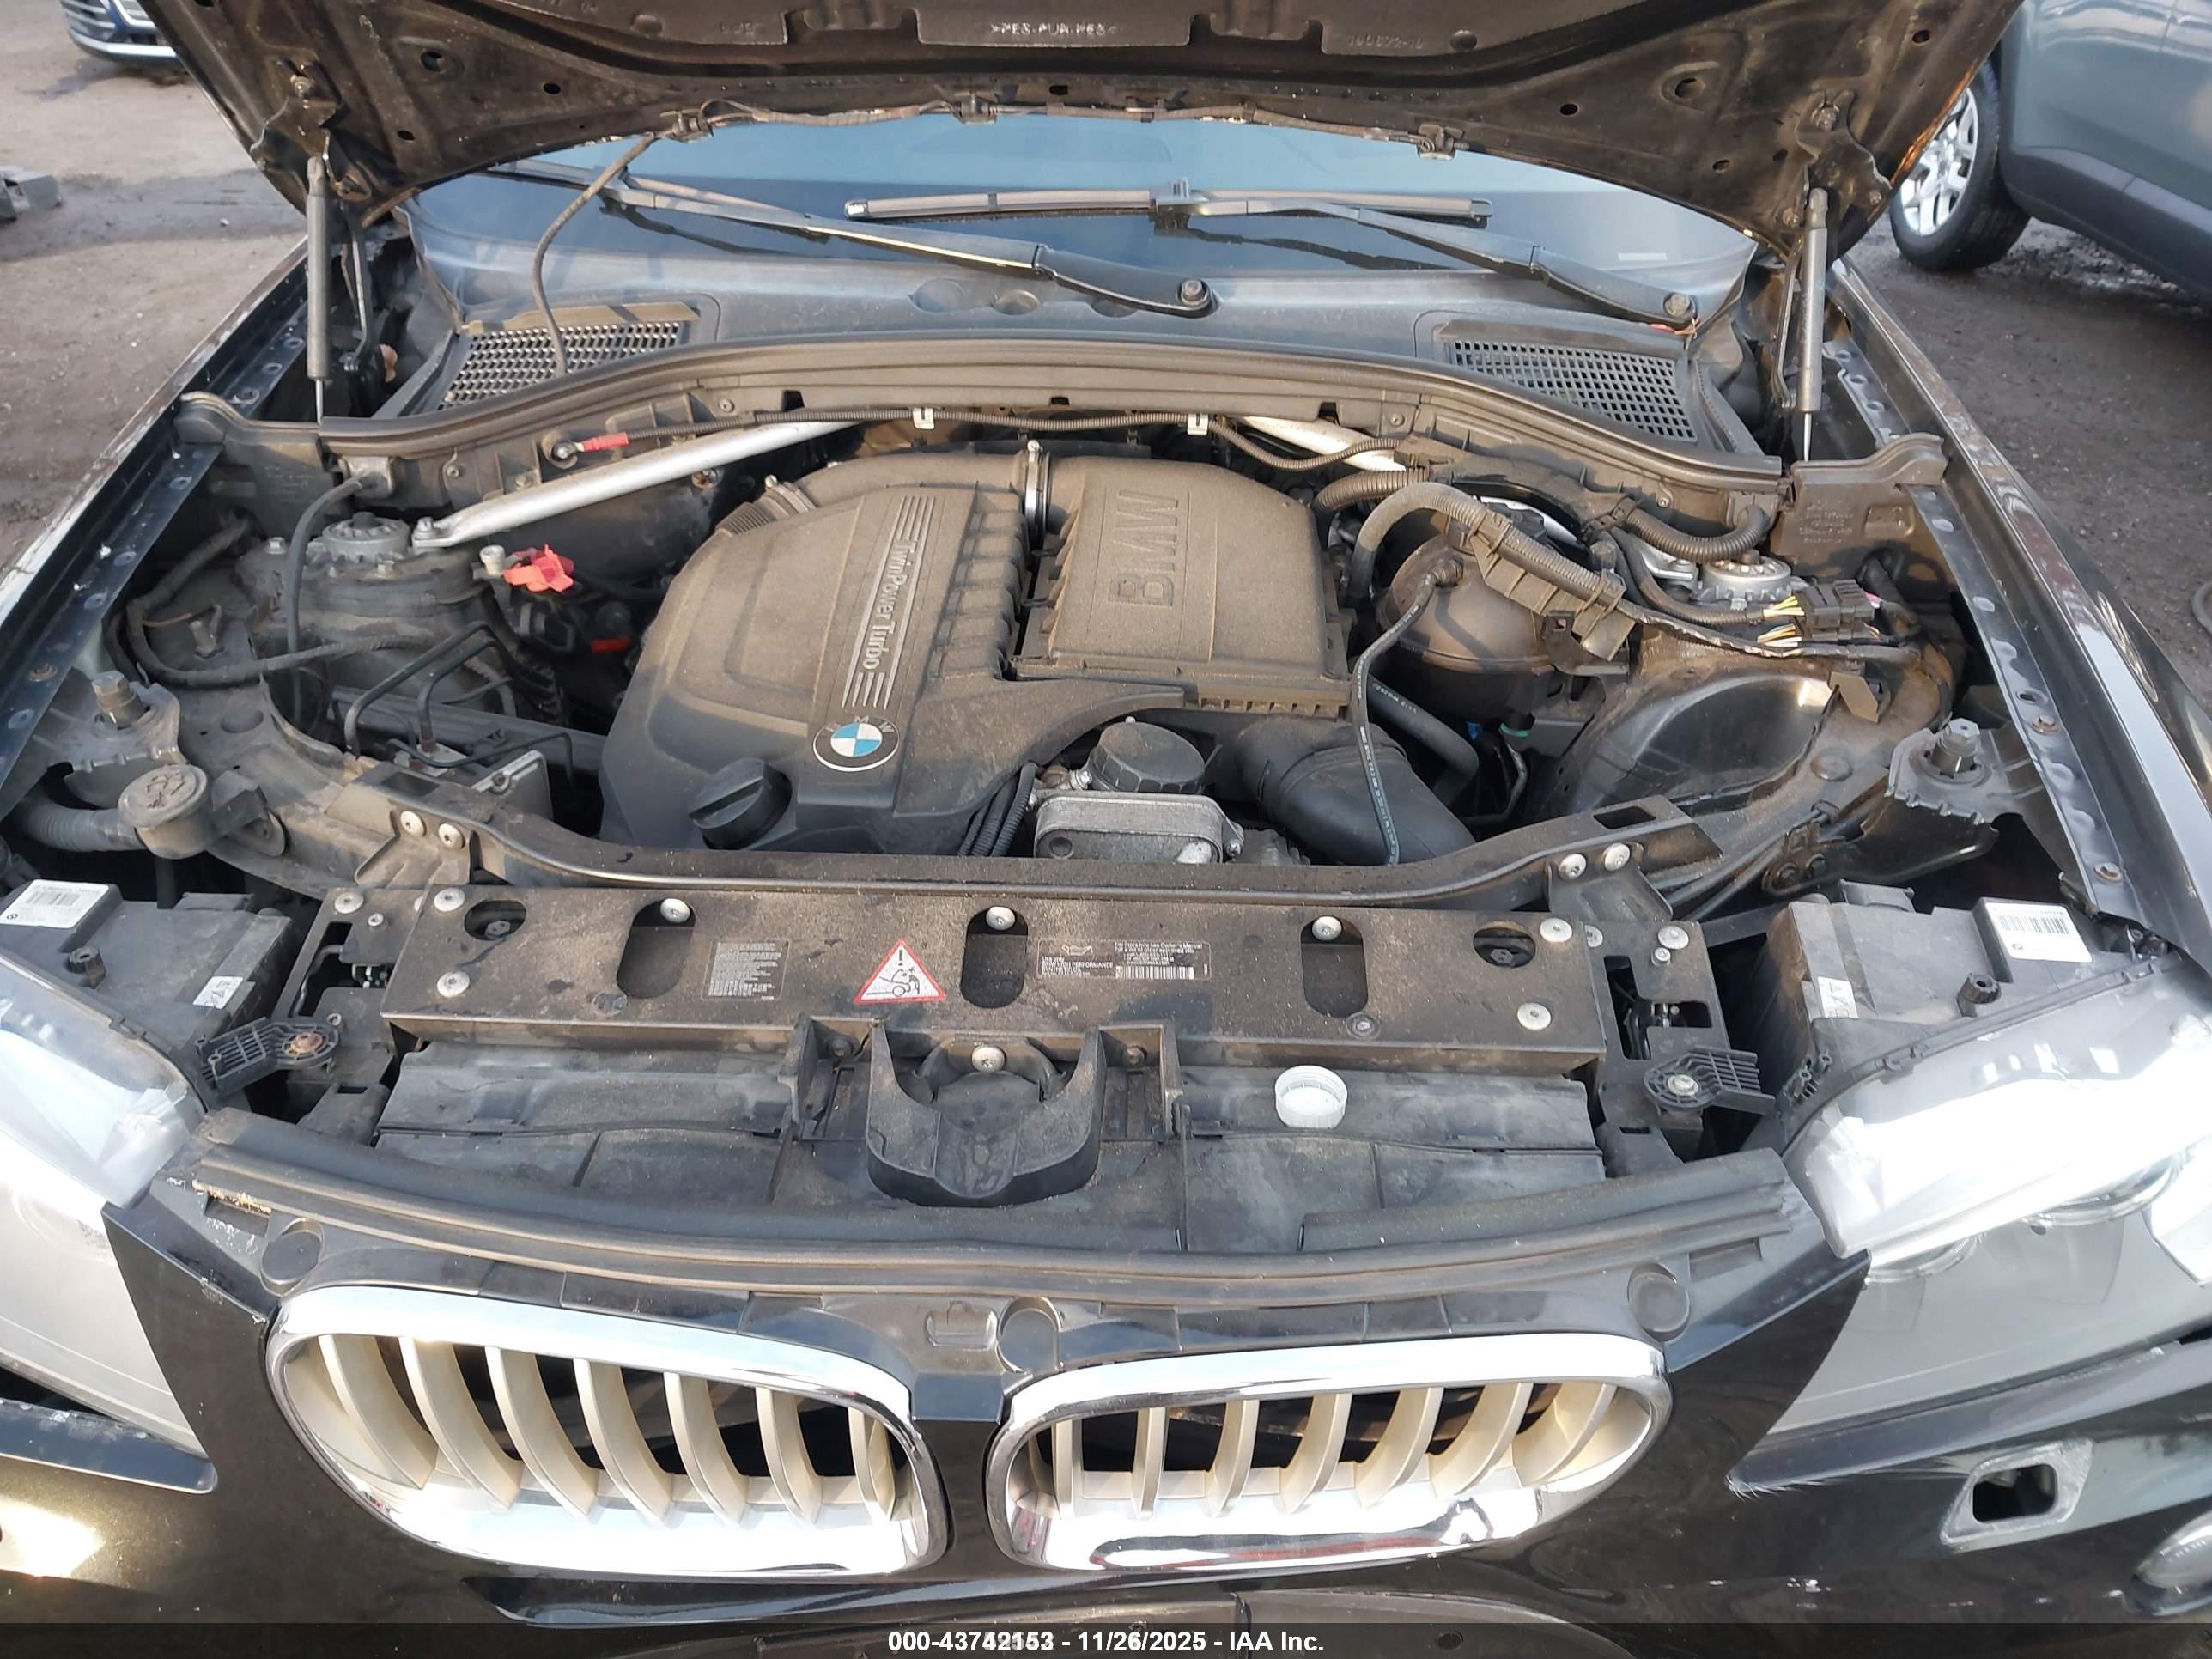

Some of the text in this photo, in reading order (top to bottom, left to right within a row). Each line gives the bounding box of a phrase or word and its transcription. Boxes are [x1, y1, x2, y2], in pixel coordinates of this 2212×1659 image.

[862, 538, 918, 670] TwinPower Turbo
[1108, 488, 1179, 607] BMW
